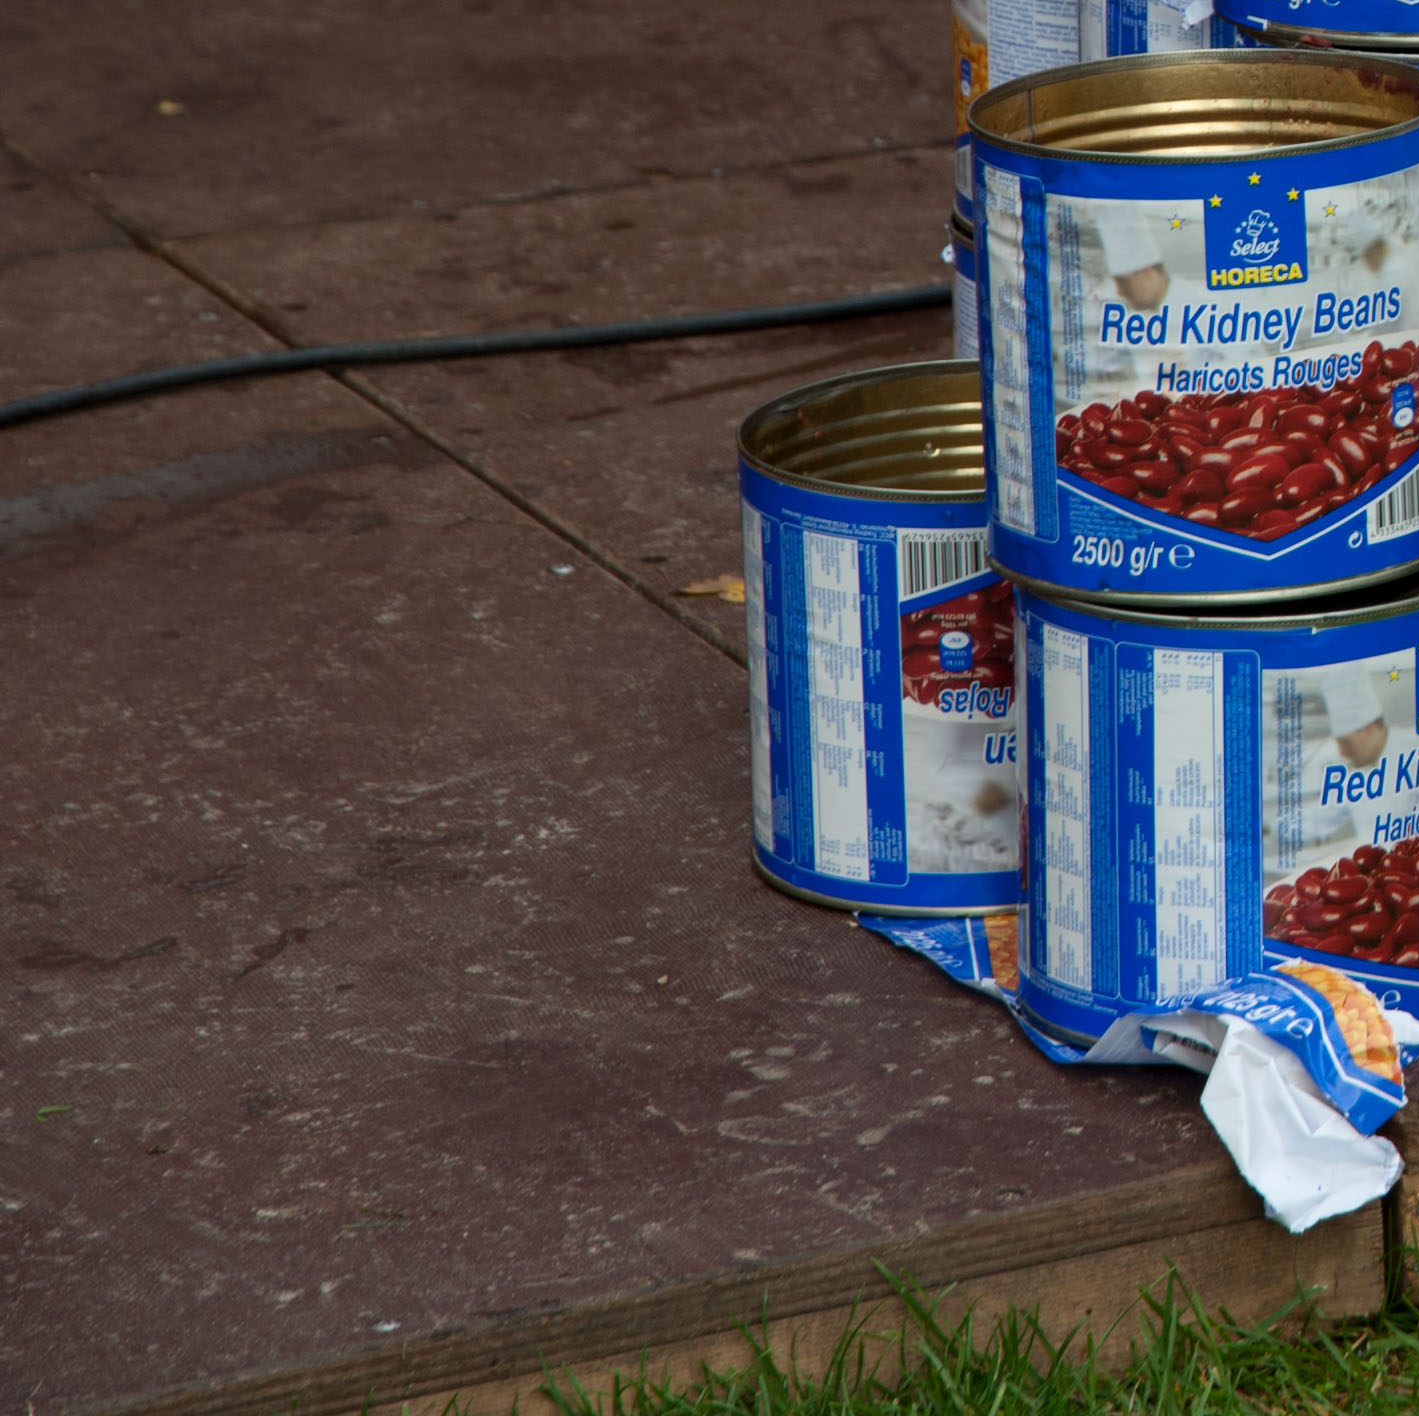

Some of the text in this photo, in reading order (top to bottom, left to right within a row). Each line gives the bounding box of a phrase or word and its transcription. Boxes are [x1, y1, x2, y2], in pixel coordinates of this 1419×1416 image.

[1230, 237, 1280, 257] Select
[1211, 262, 1303, 287] HORECA
[1101, 287, 1401, 350] Red Kidney Beans
[1156, 351, 1363, 392] Haricots Rouges
[1072, 534, 1124, 569] 2500
[940, 681, 1010, 719] Rojas
[1321, 757, 1387, 806] Red
